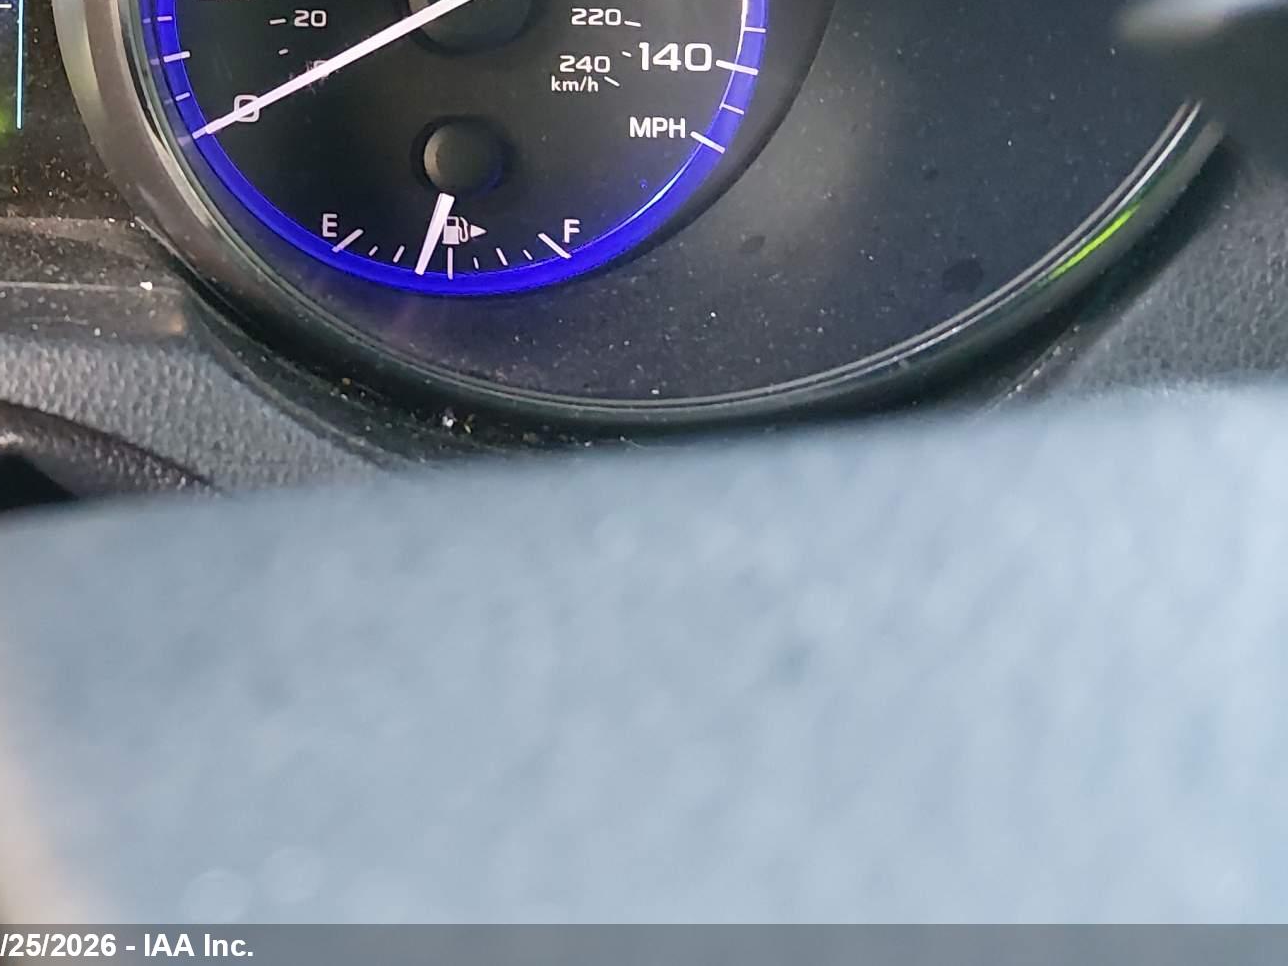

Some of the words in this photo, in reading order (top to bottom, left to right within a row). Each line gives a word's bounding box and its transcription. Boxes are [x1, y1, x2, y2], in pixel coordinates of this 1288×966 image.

[293, 9, 327, 28] 20
[571, 7, 622, 26] 220
[559, 54, 611, 74] 240
[638, 41, 713, 72] 140
[550, 75, 600, 93] km/h
[233, 95, 261, 123] 0
[629, 116, 686, 139] MPH
[323, 214, 338, 237] E
[564, 220, 580, 242] F
